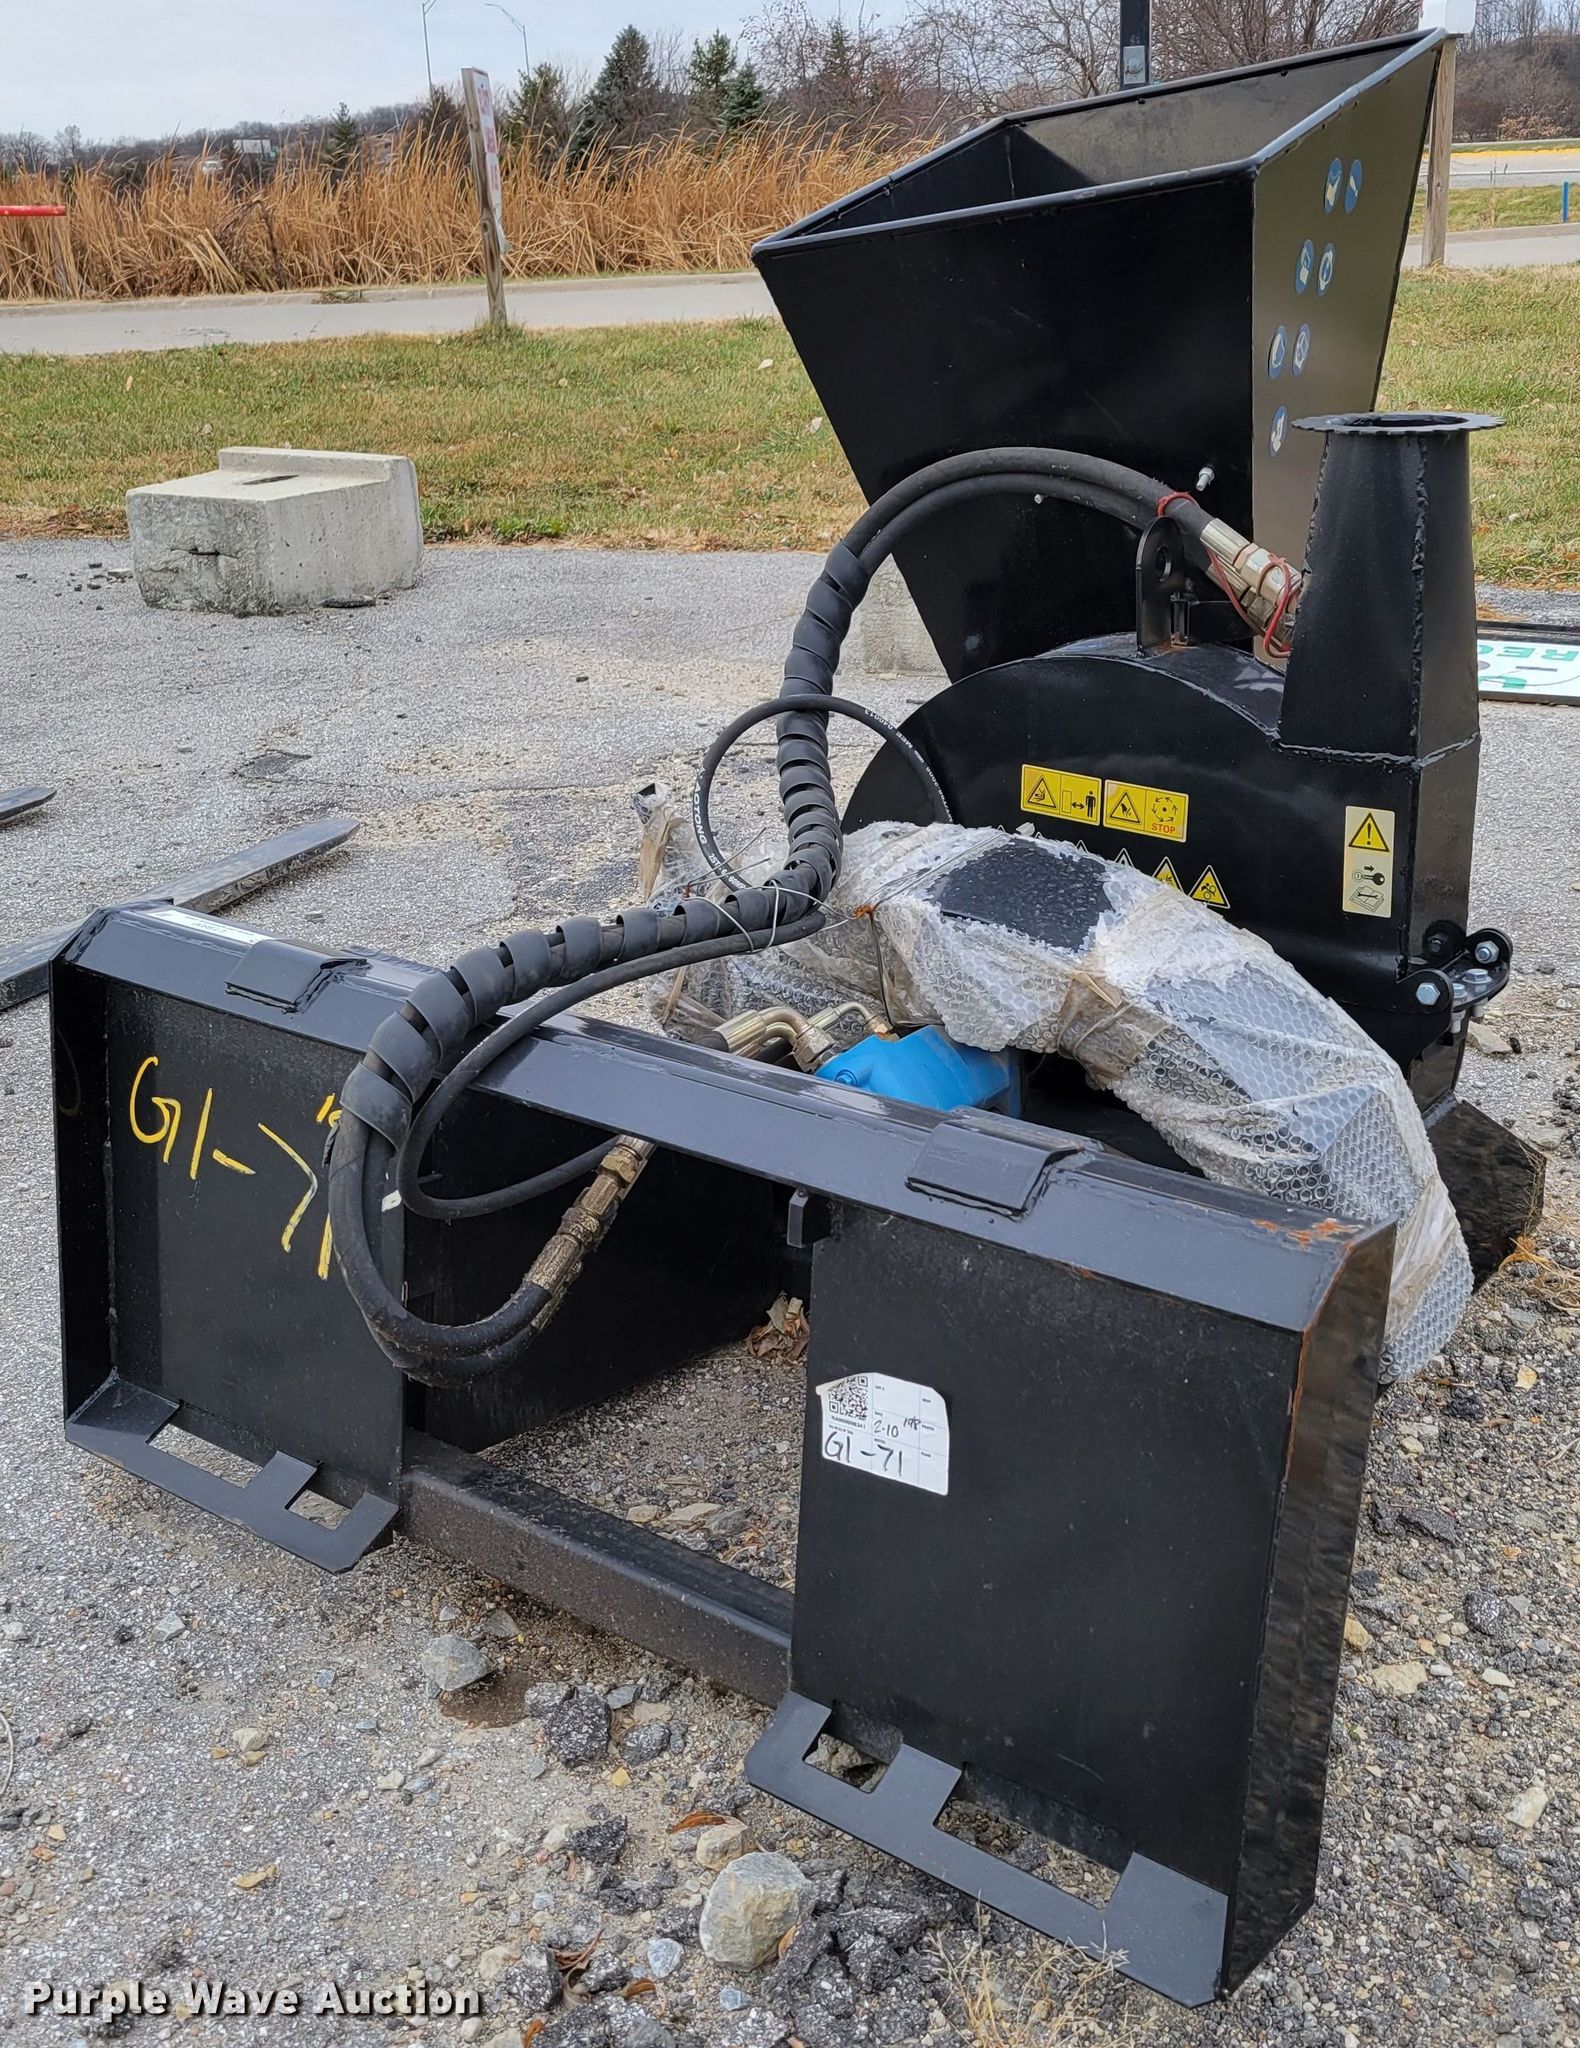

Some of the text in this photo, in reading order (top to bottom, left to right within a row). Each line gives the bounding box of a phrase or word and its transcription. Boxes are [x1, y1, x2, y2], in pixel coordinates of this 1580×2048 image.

[693, 781, 708, 845] AOTONG
[1151, 822, 1176, 834] STOP
[825, 1431, 903, 1477] G1-71
